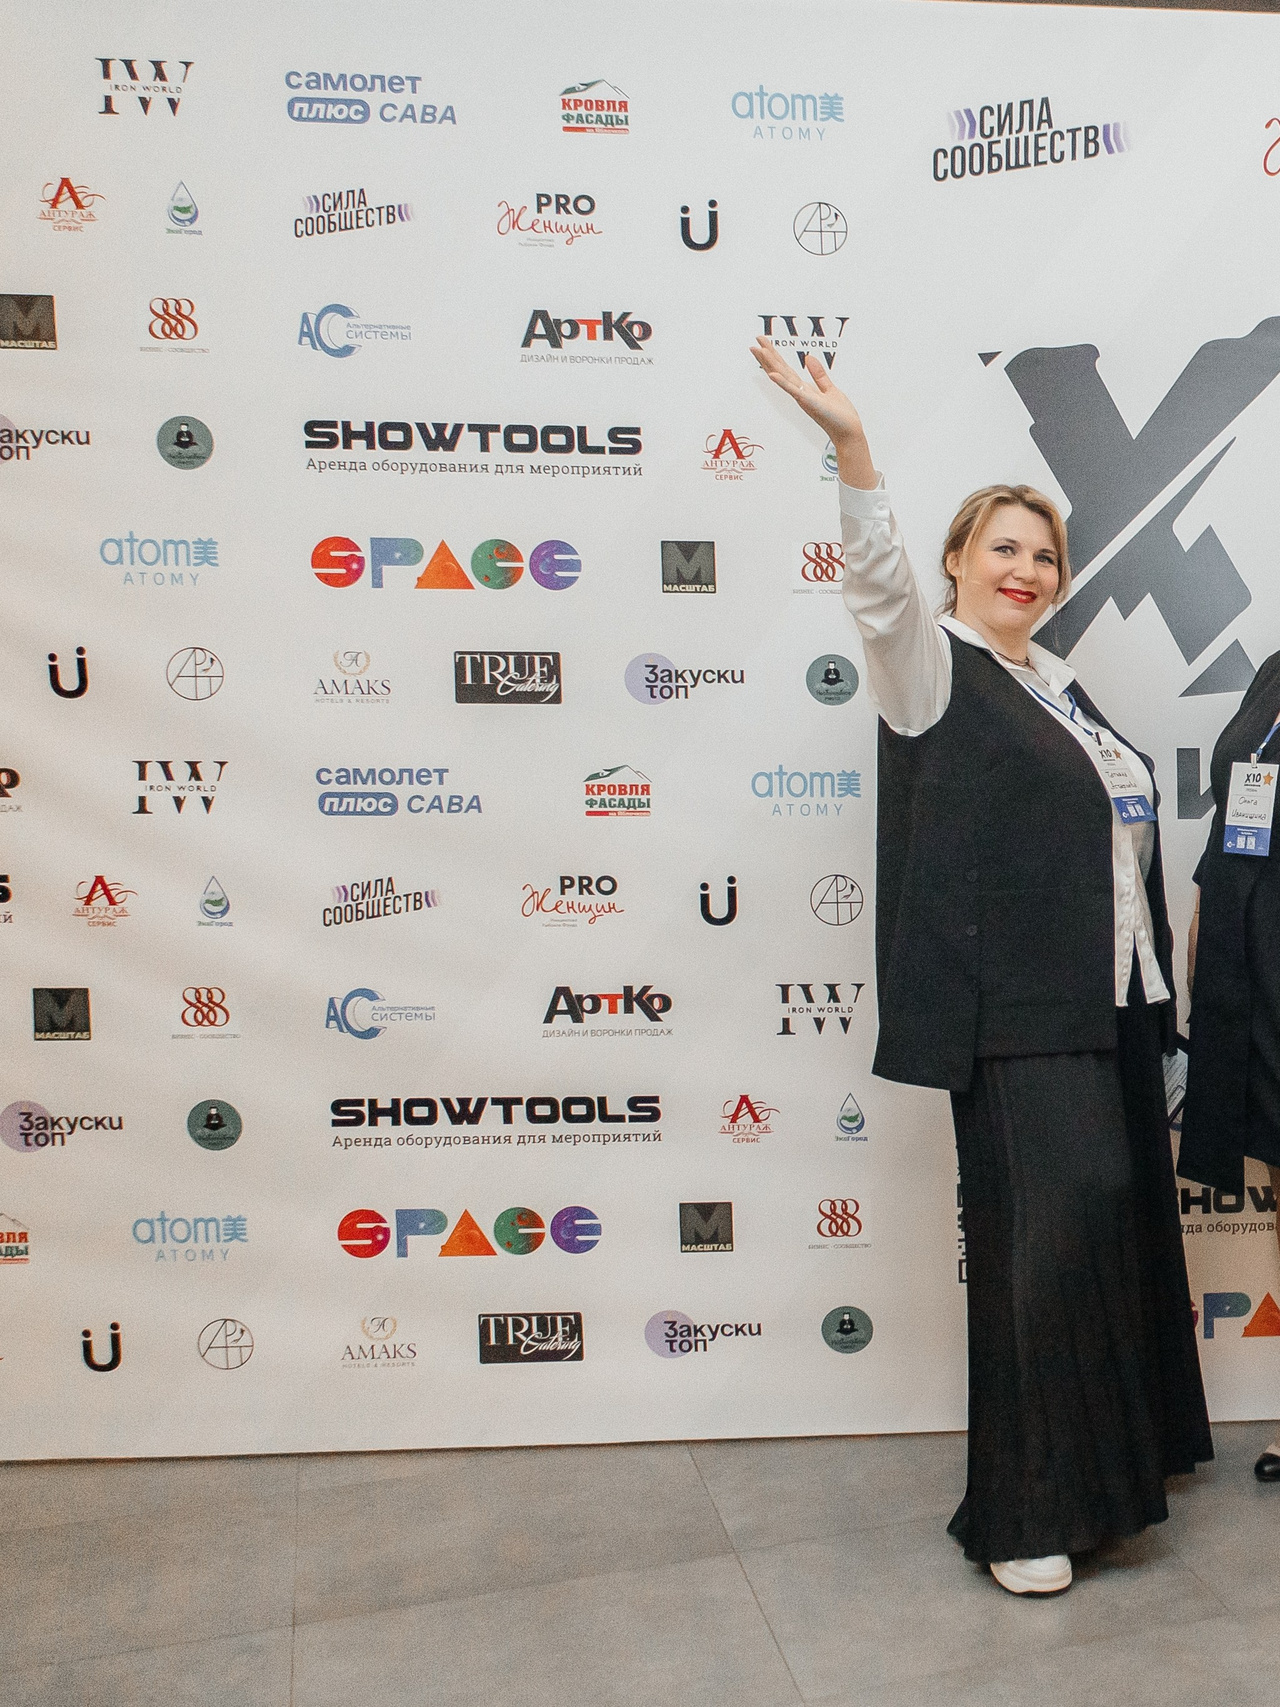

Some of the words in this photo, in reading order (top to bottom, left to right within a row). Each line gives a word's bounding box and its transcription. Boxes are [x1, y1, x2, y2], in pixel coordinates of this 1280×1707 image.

[109, 83, 137, 93] IRON
[142, 84, 183, 94] WORLD
[284, 69, 422, 94] самолет
[291, 101, 365, 121] плюс
[379, 103, 457, 125] САВА
[560, 97, 629, 113] КРОВЛЯ
[561, 112, 629, 127] ФАСАДЫ
[978, 97, 1053, 140] СИЛА
[753, 125, 826, 141] ATOMY
[933, 124, 1099, 182] СООБЩЕСТВ
[321, 188, 367, 213] СИЛА
[536, 193, 595, 216] PRO
[38, 208, 97, 219] АНТУРАЖ
[294, 205, 396, 238] СООБЩЕСТВ
[497, 201, 603, 245] Женщин
[52, 224, 84, 233] СЕРВИС
[0, 340, 56, 349] МАСШТАБ
[520, 354, 558, 364] ДИЗАЙН
[569, 355, 611, 365] ВОРОНКИ
[614, 356, 654, 366] ПРОДАЖ
[304, 420, 642, 455] SHOWTOOLS
[306, 457, 367, 473] Аренда
[372, 458, 489, 476] оборудования
[495, 462, 525, 477] для
[530, 461, 643, 477] мероприятий
[703, 459, 755, 469] АНТУРАЖ
[311, 536, 582, 590] SPACE
[123, 572, 200, 586] ATOMY
[663, 584, 716, 593] МАСШТАБ
[456, 653, 554, 687] TRUE
[644, 665, 744, 689] Закуски
[314, 679, 391, 696] AMAKS
[496, 672, 560, 702] Catering
[645, 685, 689, 700] топ
[316, 767, 449, 786] самолет
[585, 784, 651, 797] КРОВЛЯ
[322, 796, 393, 814] плюс
[407, 795, 483, 814] САВА
[584, 796, 651, 810] ФАСАДЫ
[772, 803, 843, 817] ATOMY
[350, 877, 395, 902] СИЛА
[560, 875, 617, 896] PRO
[323, 892, 423, 927] СООБЩЕСТВ
[522, 883, 625, 924] Женщин
[542, 1029, 579, 1038] ДИЗАЙН
[591, 1029, 632, 1037] ВОРОНКИ
[635, 1028, 673, 1037] ПРОДАЖ
[331, 1095, 661, 1127] SHOWTOOLS
[19, 1112, 123, 1136] Закуски
[720, 1123, 771, 1132] АНТУРАЖ
[20, 1130, 66, 1147] топ
[332, 1134, 392, 1150] Аренда
[397, 1133, 512, 1148] оборудования
[517, 1133, 546, 1146] для
[552, 1129, 662, 1146] мероприятий
[337, 1206, 602, 1258] SPACE
[155, 1249, 230, 1262] ATOMY
[682, 1243, 732, 1252] МАСШТАБ
[480, 1314, 575, 1346] TRUE
[663, 1320, 762, 1342] Закуски
[341, 1343, 417, 1360] AMAKS
[665, 1339, 708, 1353] топ
